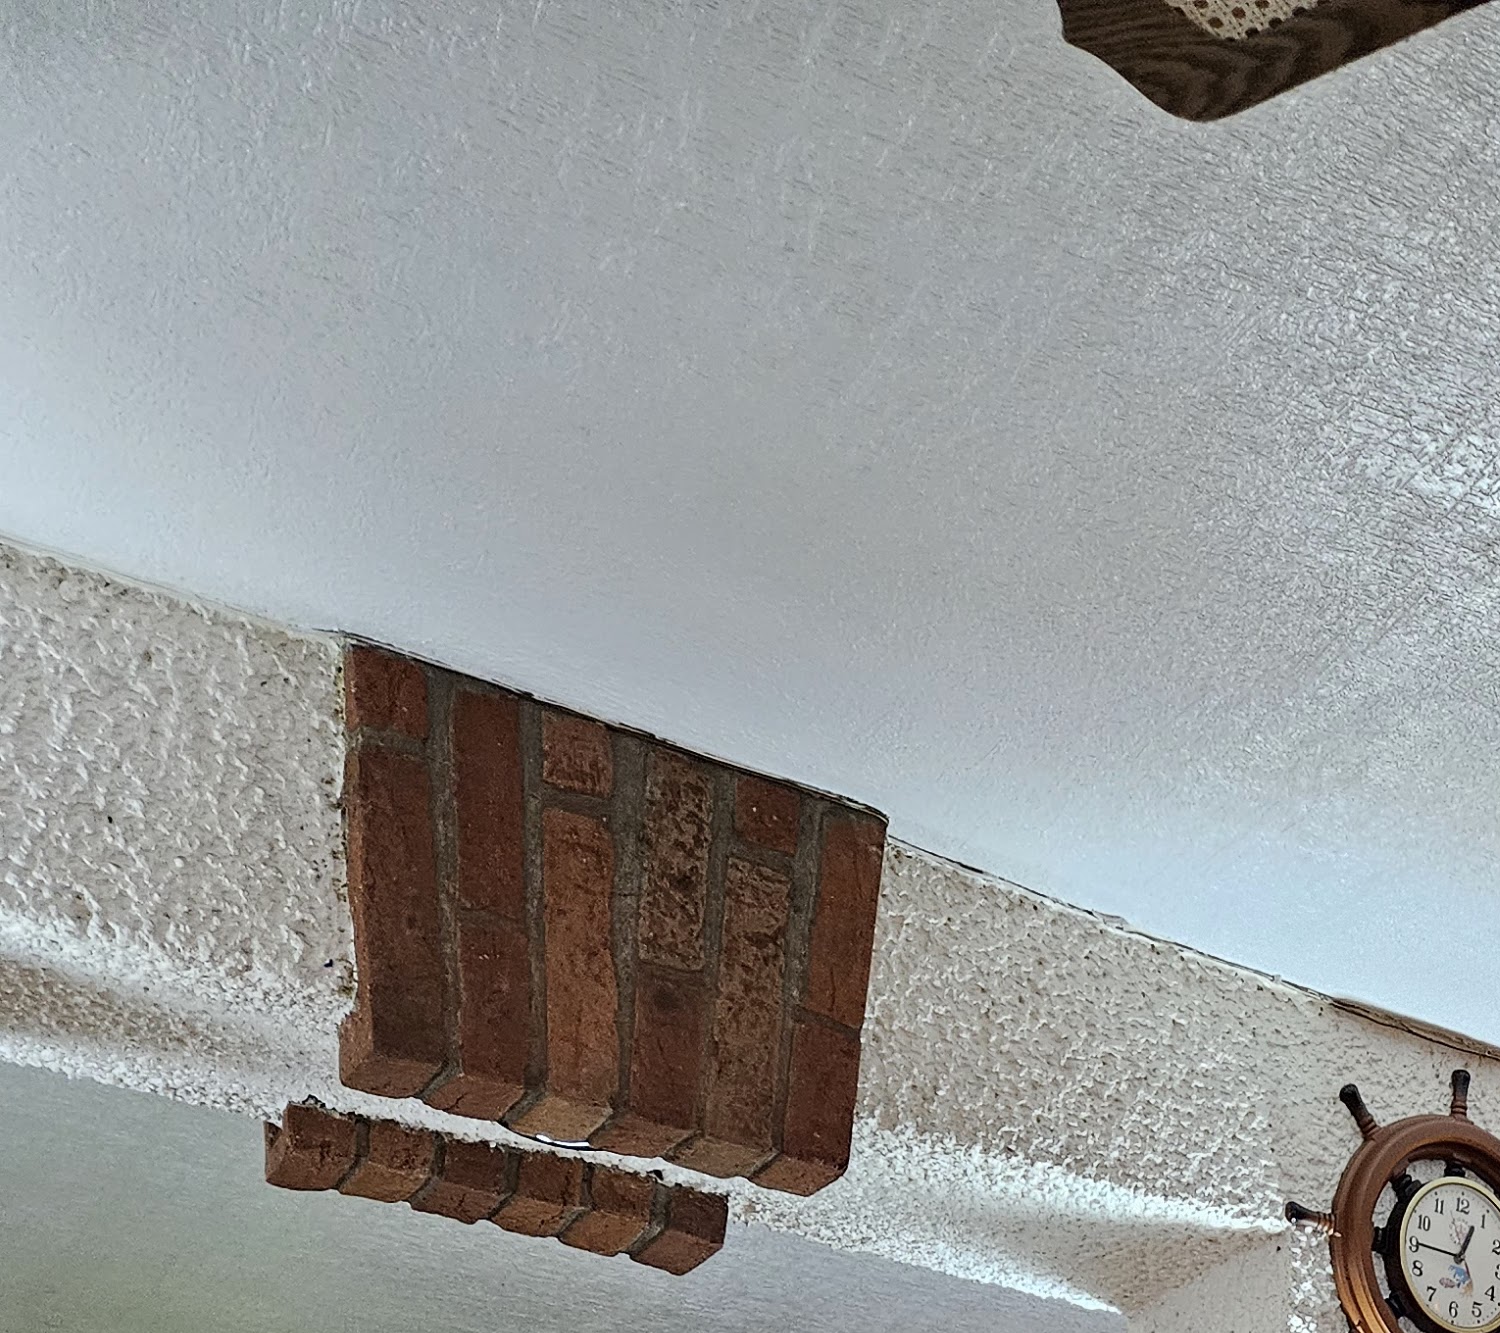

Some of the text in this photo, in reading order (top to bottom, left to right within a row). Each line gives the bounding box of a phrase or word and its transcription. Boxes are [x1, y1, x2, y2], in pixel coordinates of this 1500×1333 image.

[1434, 1198, 1444, 1215] 11
[1456, 1197, 1470, 1215] 12
[1418, 1215, 1431, 1232] 10
[1481, 1214, 1486, 1229] 1
[1409, 1236, 1419, 1253] 9
[1412, 1260, 1423, 1277] 8
[1427, 1286, 1437, 1302] 7
[1484, 1285, 1495, 1302] 4
[1448, 1301, 1459, 1318] 6
[1471, 1301, 1483, 1317] 5
